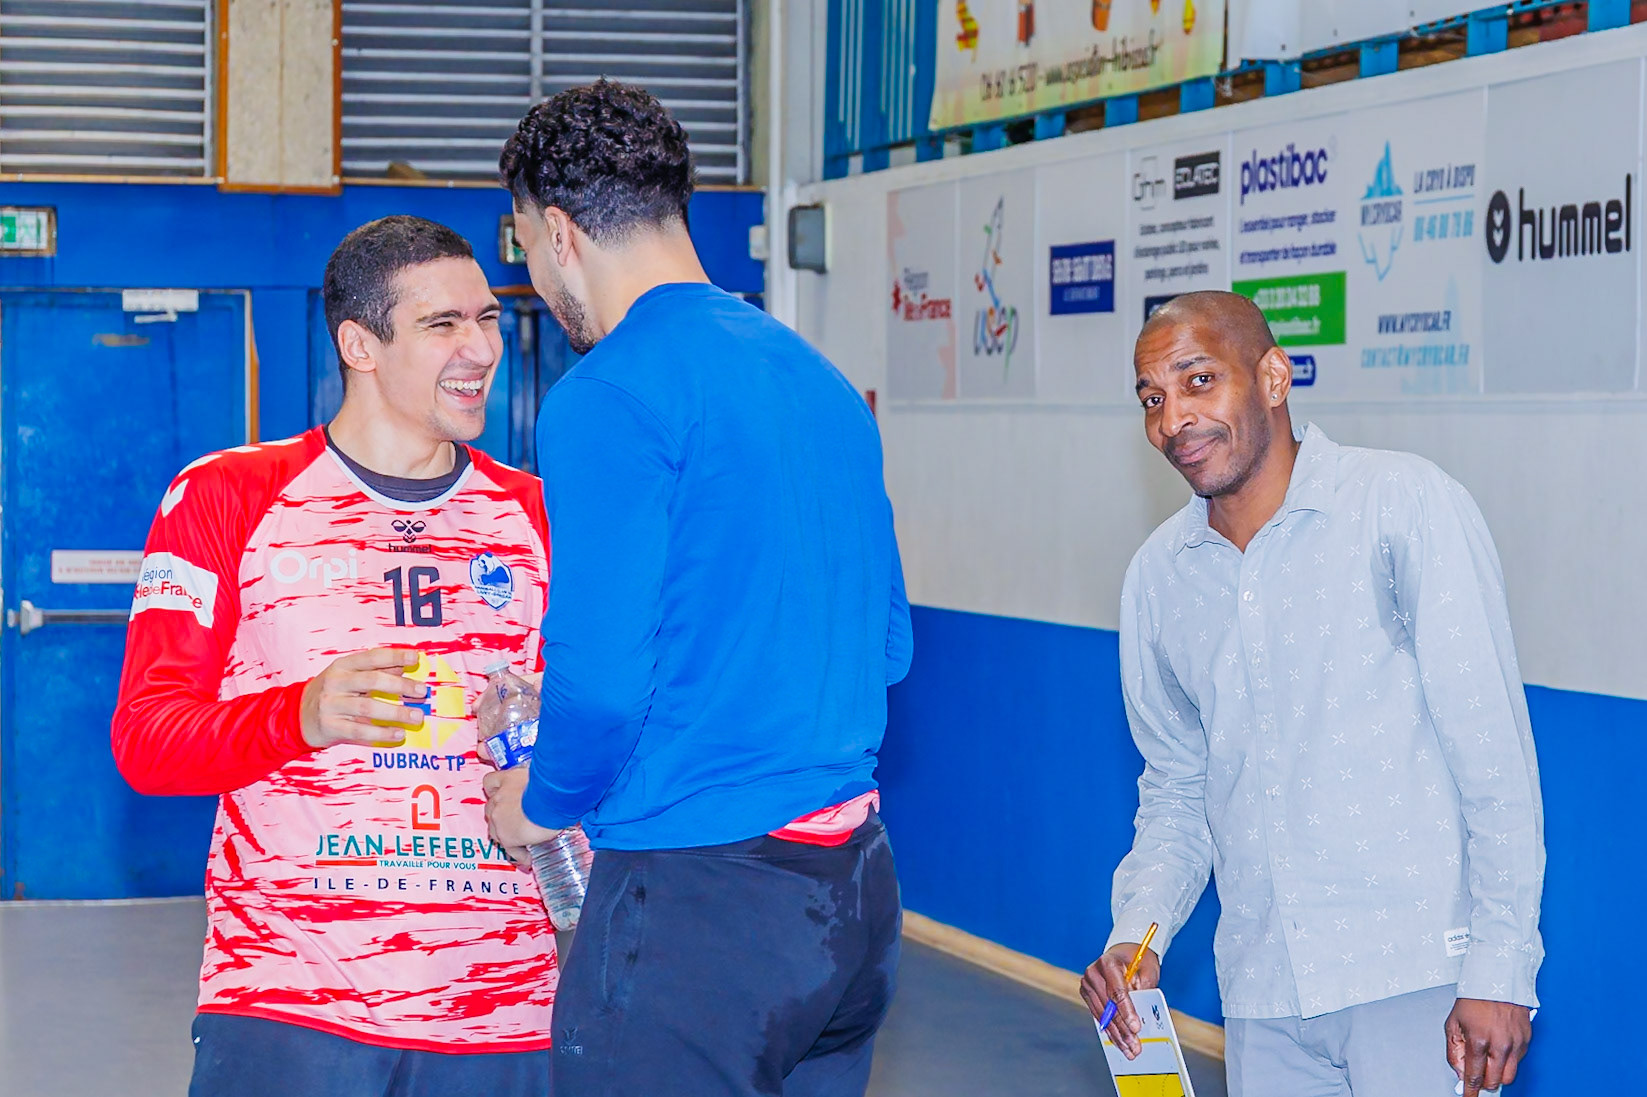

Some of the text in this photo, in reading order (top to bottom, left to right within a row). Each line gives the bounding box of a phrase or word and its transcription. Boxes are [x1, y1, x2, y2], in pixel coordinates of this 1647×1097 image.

[1240, 142, 1328, 205] plastibac
[1518, 173, 1632, 262] hummel
[388, 543, 432, 553] hummel
[142, 566, 173, 583] égion
[269, 548, 358, 588] Orpi
[384, 565, 443, 627] 16
[372, 752, 466, 771] DUBRAC TP
[315, 834, 517, 862] JEAN LEFEBVR
[379, 859, 477, 871] TRAVAILLE POUR VOUS
